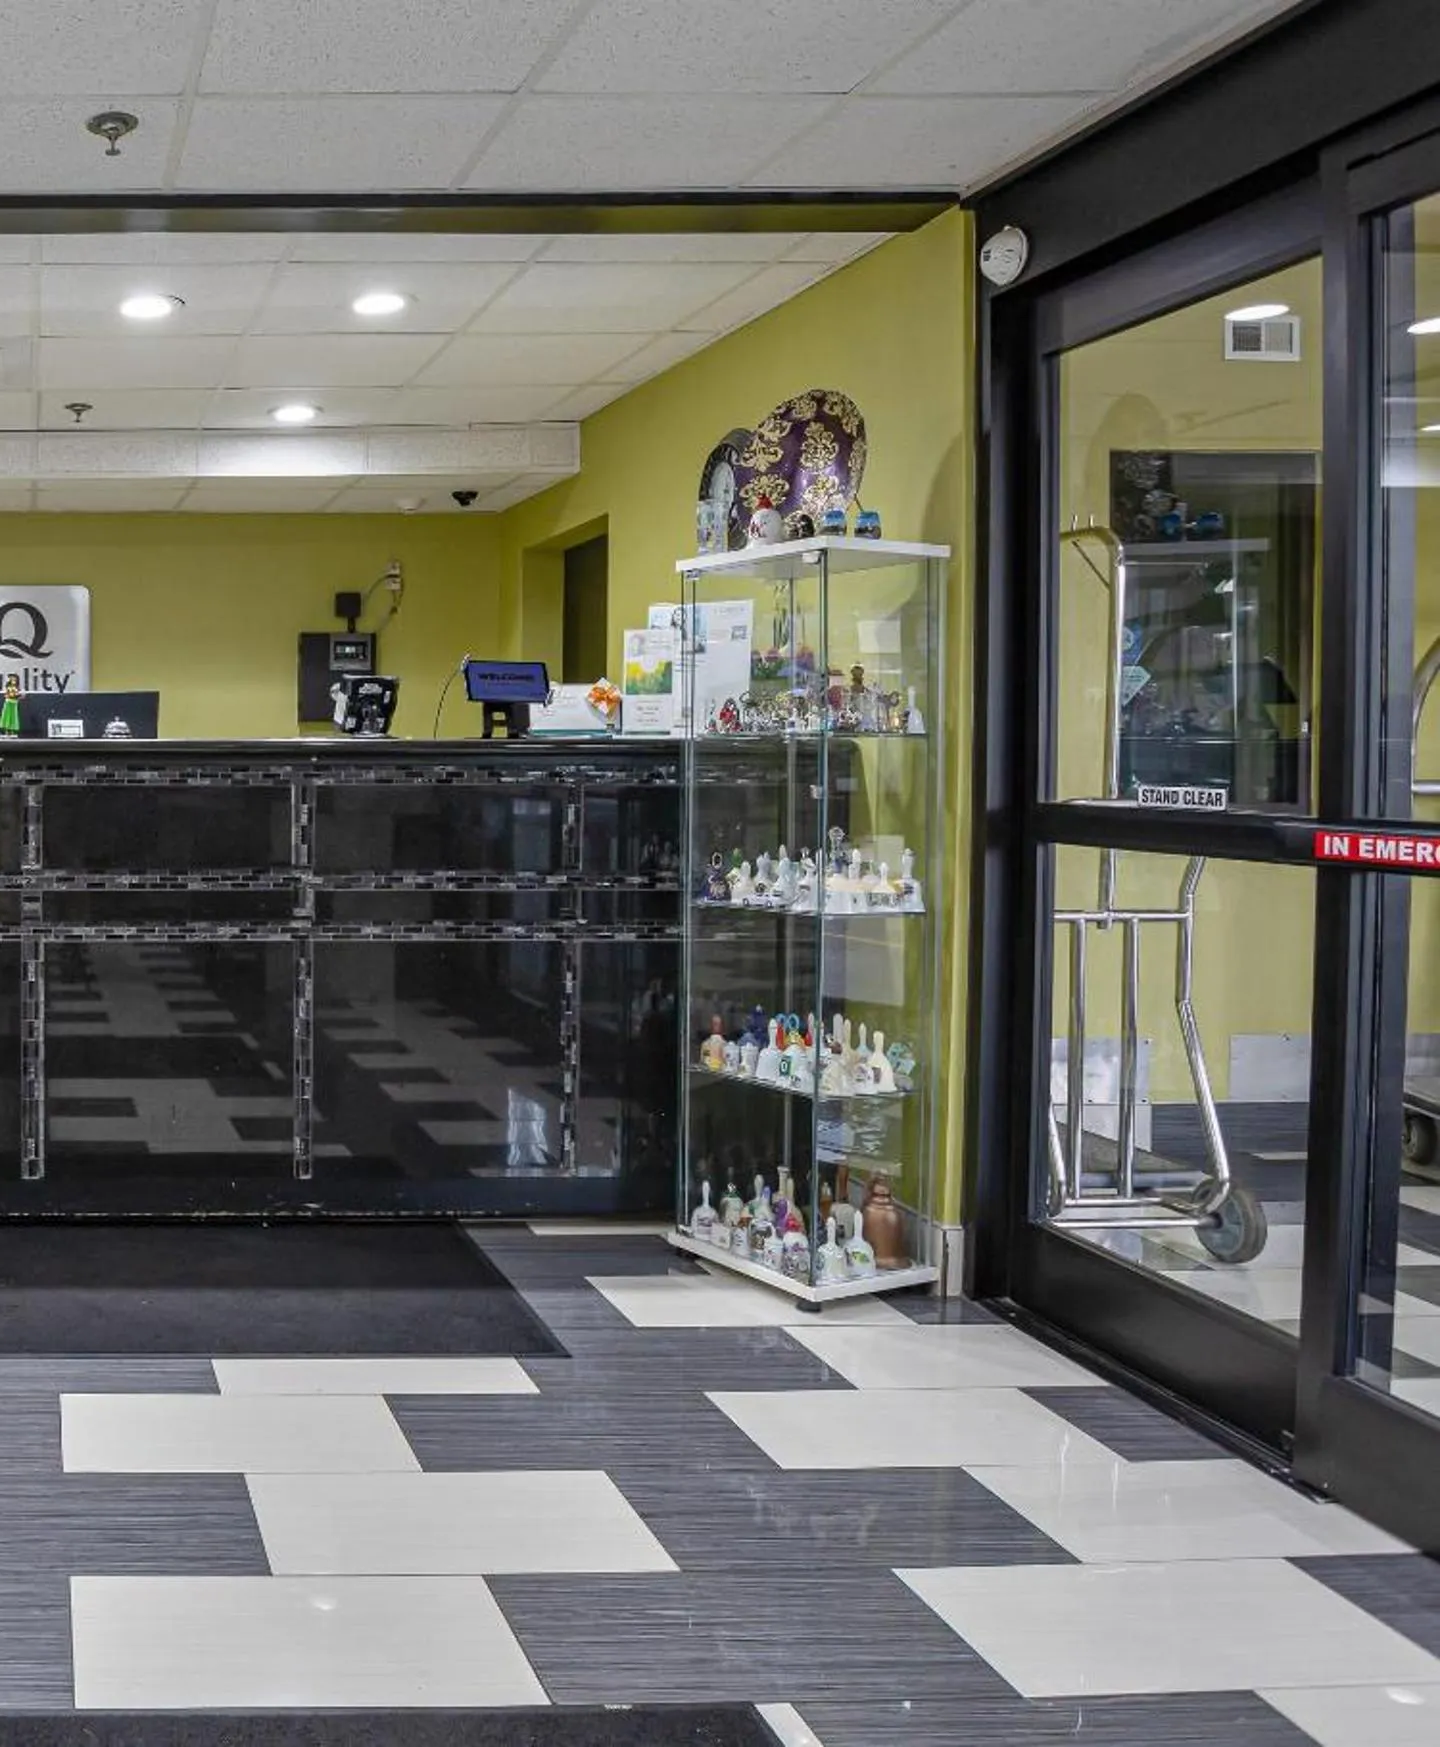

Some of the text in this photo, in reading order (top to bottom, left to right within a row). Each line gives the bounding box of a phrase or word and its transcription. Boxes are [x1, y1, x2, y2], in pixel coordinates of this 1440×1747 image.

[1142, 788, 1223, 807] STAND CLEAR
[1324, 835, 1440, 864] IN EMER
